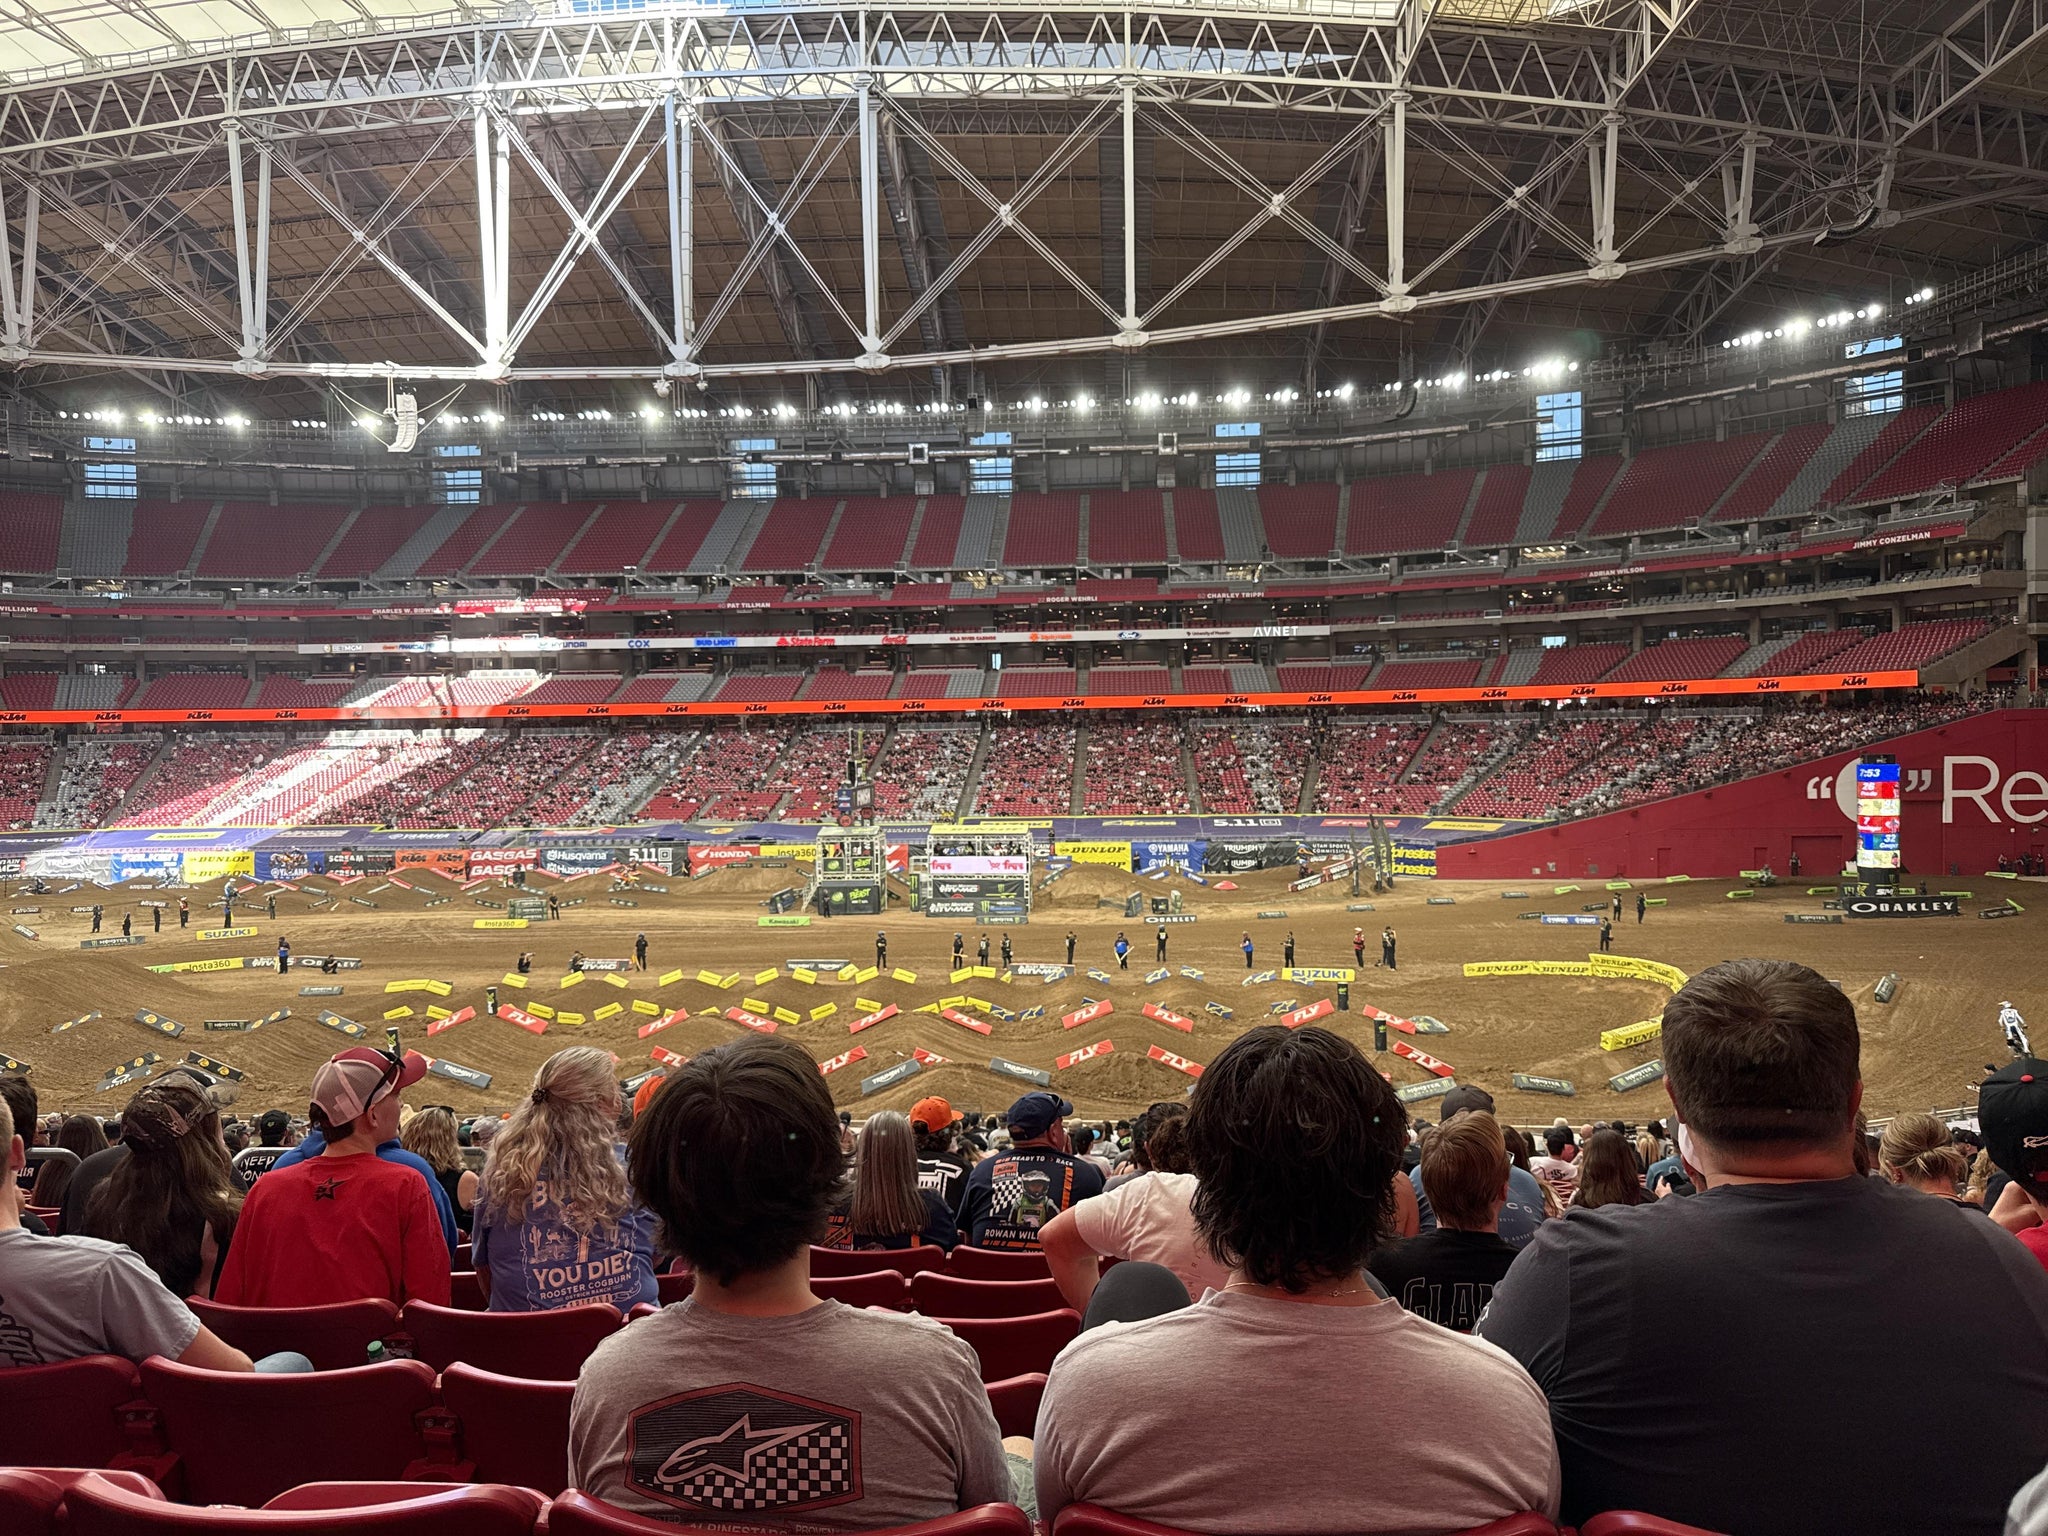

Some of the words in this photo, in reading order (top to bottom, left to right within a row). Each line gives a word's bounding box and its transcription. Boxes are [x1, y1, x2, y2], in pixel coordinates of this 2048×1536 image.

[1852, 538, 1878, 550] JIMMY
[1879, 532, 1931, 545] CONZELMAN
[1616, 566, 1646, 575] WILSON
[1253, 626, 1299, 637] AVNET
[628, 640, 650, 648] COX
[791, 637, 809, 646] State
[813, 637, 836, 646] Farm
[1756, 680, 1780, 690] KTM
[1841, 674, 1868, 686] KTM
[1571, 686, 1596, 696] KTM
[1660, 682, 1688, 693] KTM
[1308, 694, 1332, 703] KTM
[1392, 692, 1418, 701] KTM
[1480, 689, 1508, 698] KTM
[982, 700, 1005, 709] KTM
[1062, 698, 1085, 708] KTM
[1142, 697, 1166, 706] KTM
[1224, 696, 1249, 705] KTM
[586, 706, 610, 714] KTM
[665, 705, 688, 714] KTM
[744, 704, 768, 712] KTM
[823, 703, 846, 711] KTM
[902, 702, 926, 710] KTM
[94, 712, 122, 721] KTM
[186, 712, 213, 720] KTM
[275, 710, 298, 719] KTM
[508, 707, 531, 716] KTM
[1214, 818, 1259, 826] 5.11
[777, 848, 817, 858] Insta360
[1071, 846, 1126, 854] DUNLOP
[1157, 844, 1190, 852] YAMAHA
[1223, 844, 1258, 854] TRIUMPH
[400, 854, 427, 863] KTM
[436, 853, 464, 862] KTM
[470, 849, 537, 861] GASGAS
[556, 850, 608, 862] Husqvarna
[628, 848, 658, 862] 5.11
[280, 868, 308, 876] YAAHA
[1878, 902, 1954, 913] OAKLEY
[484, 920, 516, 928] Insta360
[204, 928, 251, 938] SUZUKI
[1600, 958, 1634, 967] DUNLOP
[1476, 964, 1529, 973] DUNLOP
[1542, 966, 1590, 974] DUNLOP
[508, 1012, 537, 1026] FLY
[859, 1009, 887, 1027] FLY
[1073, 1005, 1100, 1023] FLY
[1154, 1009, 1184, 1025] FLY
[1292, 1004, 1320, 1024] FLY
[1376, 1010, 1405, 1026] FLY
[436, 1012, 462, 1030] FLY
[648, 1014, 674, 1033] FLY
[738, 1012, 766, 1027] FLY
[954, 1014, 984, 1027] FLY
[1068, 1042, 1100, 1066] FLY
[662, 1054, 685, 1067] FL
[822, 1050, 852, 1074] FLY
[1158, 1050, 1195, 1071] FLY
[1406, 1051, 1443, 1069] FLY
[872, 1065, 903, 1085] TRIUMPH
[984, 1228, 1016, 1238] ROWAN
[1019, 1230, 1040, 1240] WIL
[532, 1264, 582, 1293] YOU
[588, 1251, 634, 1284] DIE?
[540, 1283, 586, 1301] ROOSTER
[588, 1272, 632, 1292] COGBURN
[564, 1292, 590, 1301] OSTRICH
